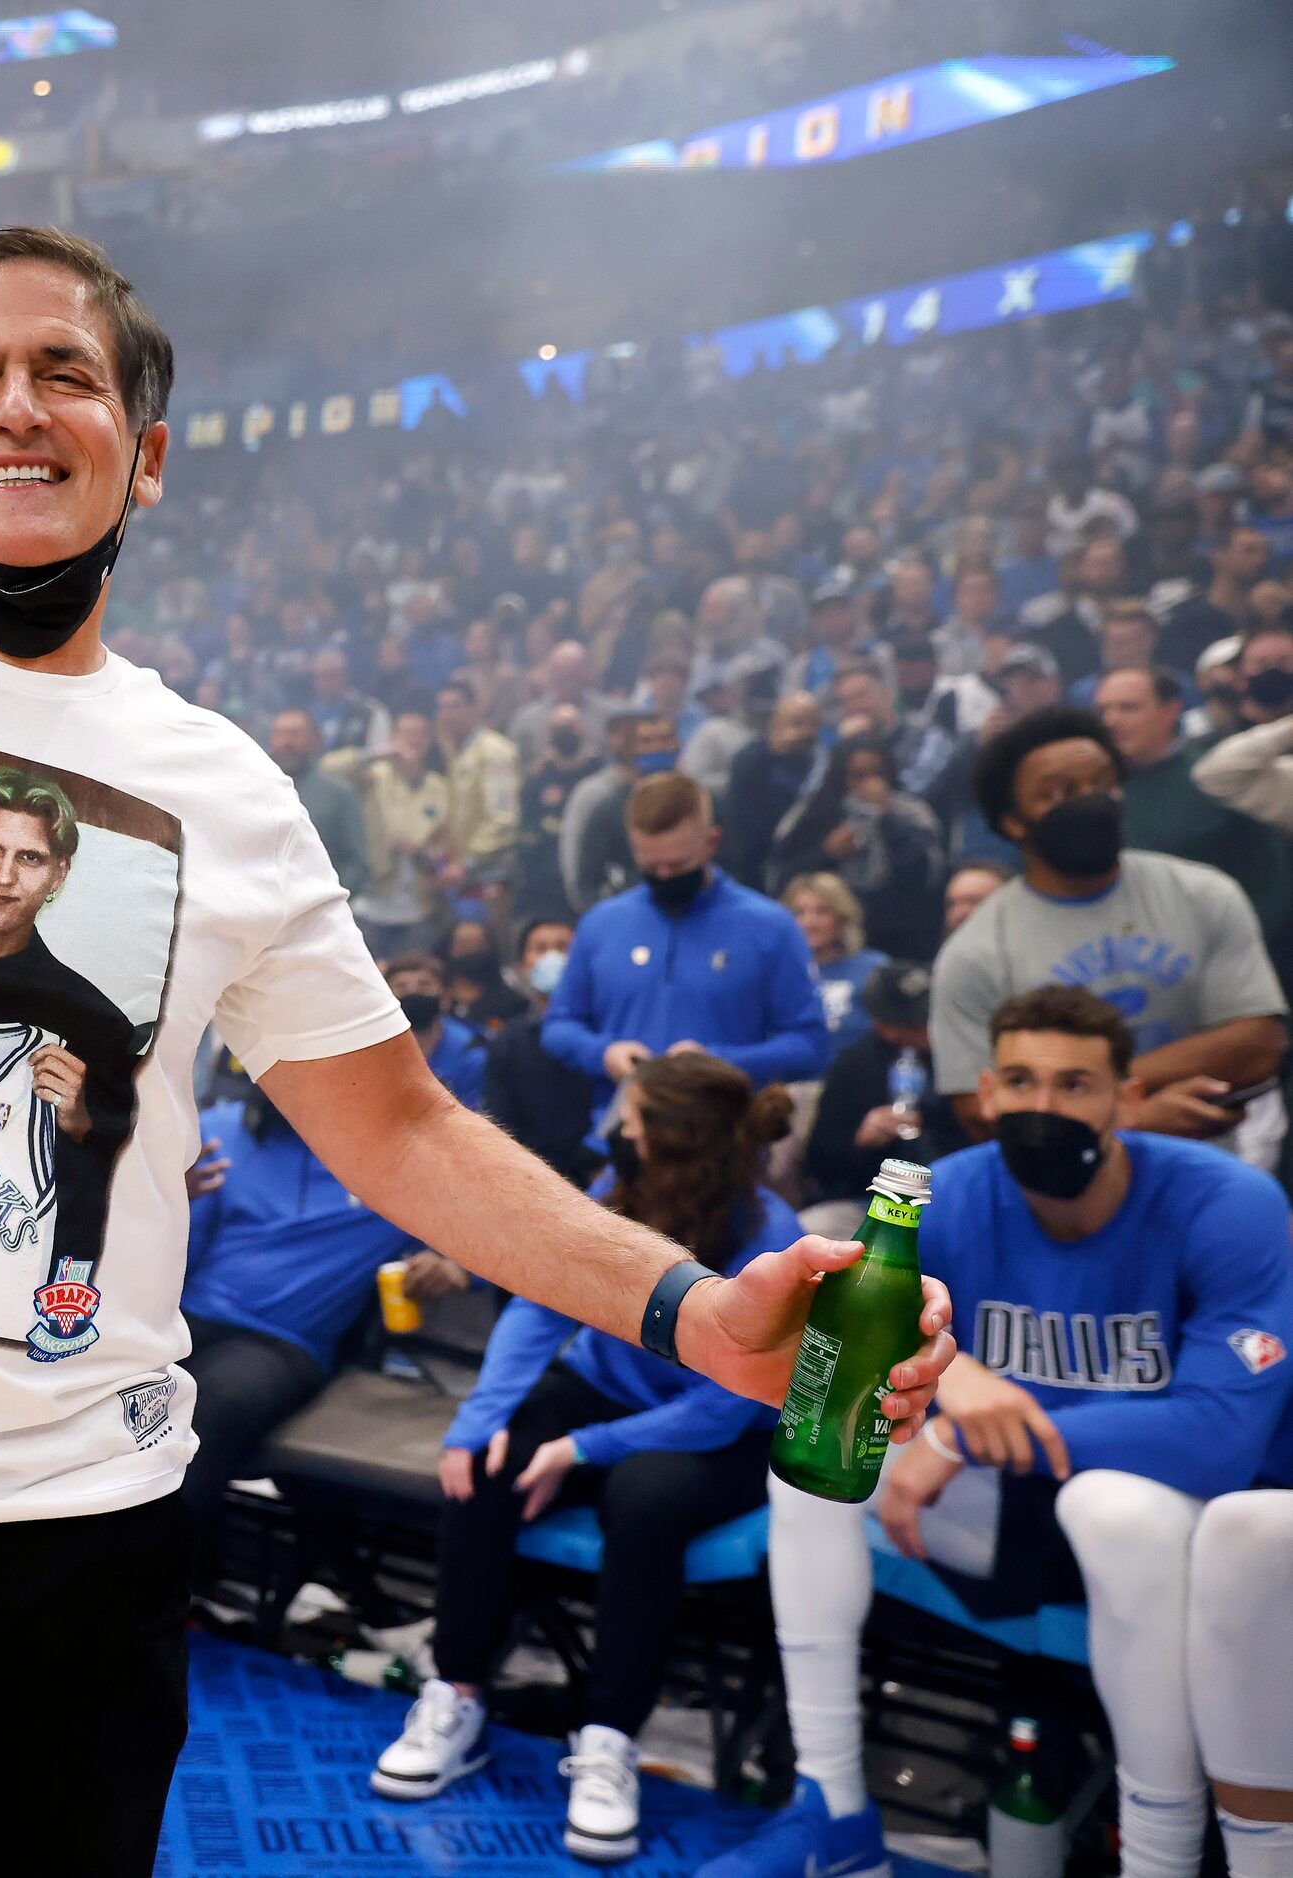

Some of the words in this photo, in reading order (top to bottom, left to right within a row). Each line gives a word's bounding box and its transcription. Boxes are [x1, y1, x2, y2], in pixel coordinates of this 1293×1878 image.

[887, 1207, 908, 1219] KEY
[67, 1266, 86, 1281] NBA
[46, 1288, 93, 1307] DRAFT
[34, 1329, 96, 1353] VANCOUVER
[973, 1300, 1172, 1391] DALLAS
[30, 1348, 49, 1361] JUNE
